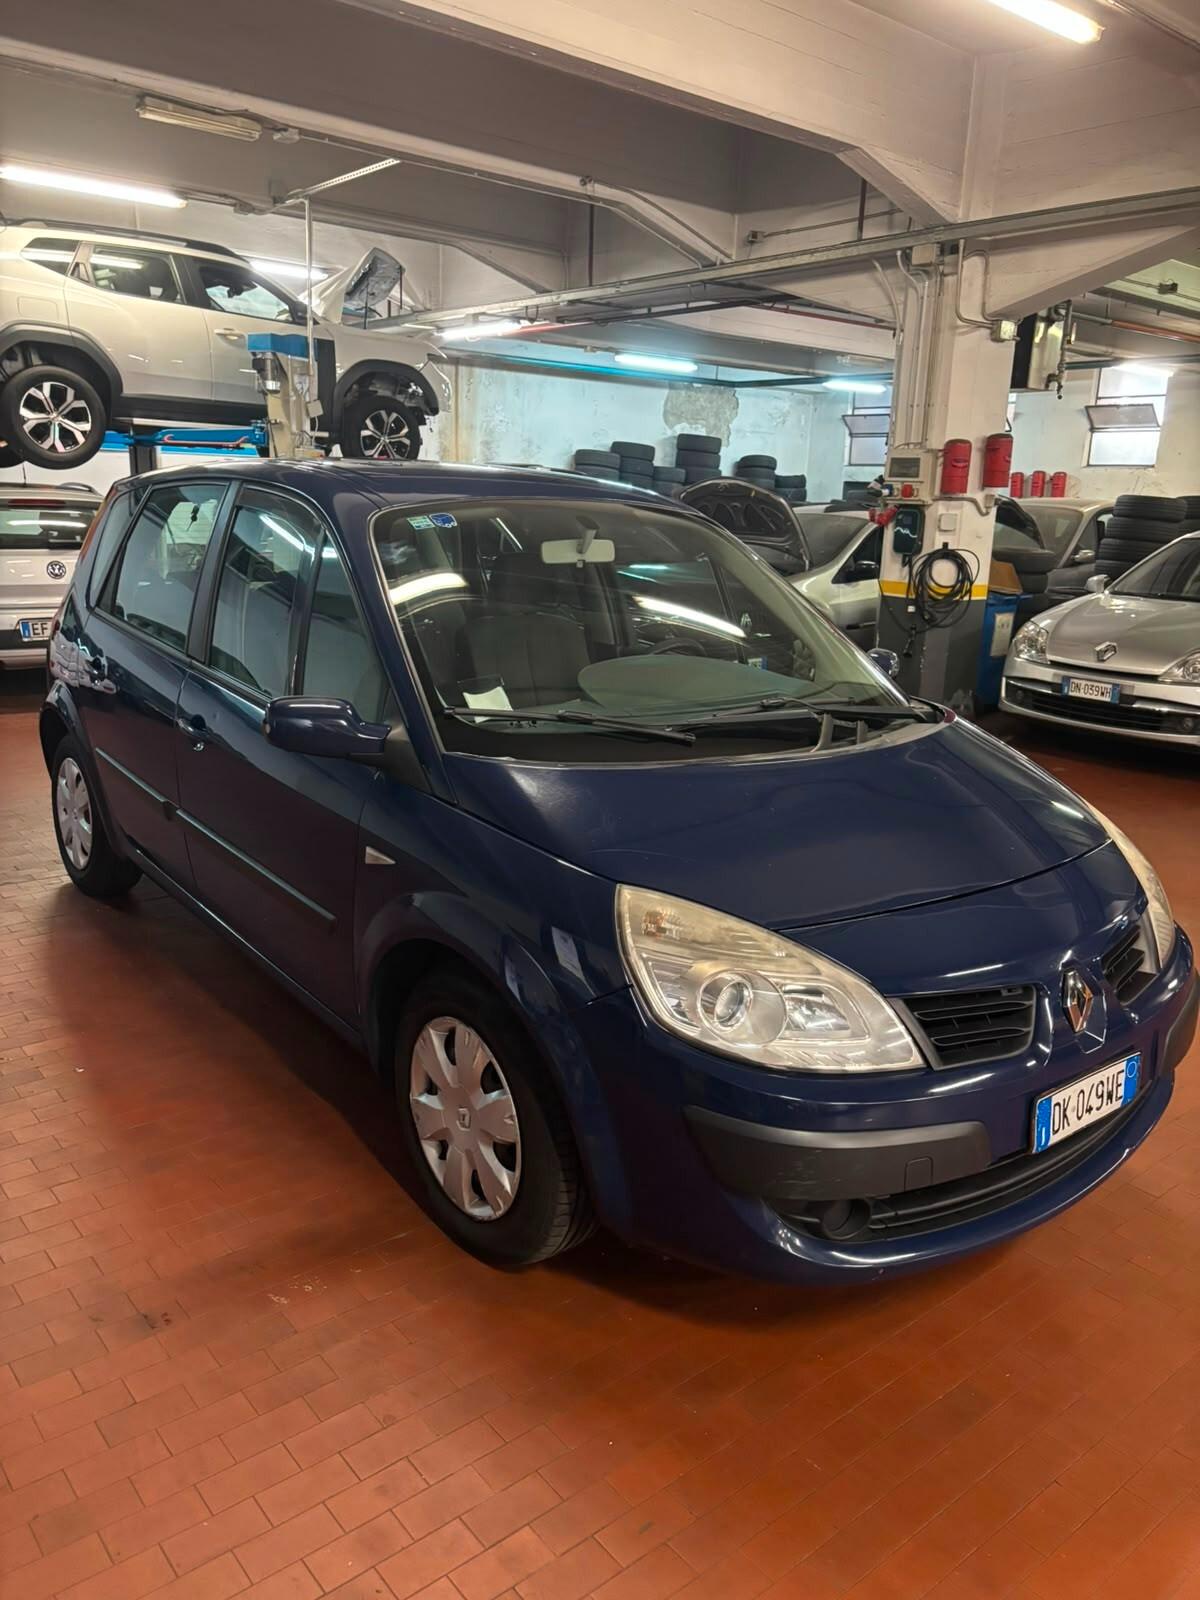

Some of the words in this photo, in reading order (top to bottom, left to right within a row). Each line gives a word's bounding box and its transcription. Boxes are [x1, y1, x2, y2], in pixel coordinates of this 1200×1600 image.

[32, 622, 48, 636] EF
[1052, 1095, 1071, 1136] DK
[1076, 1069, 1125, 1121] 049WE
